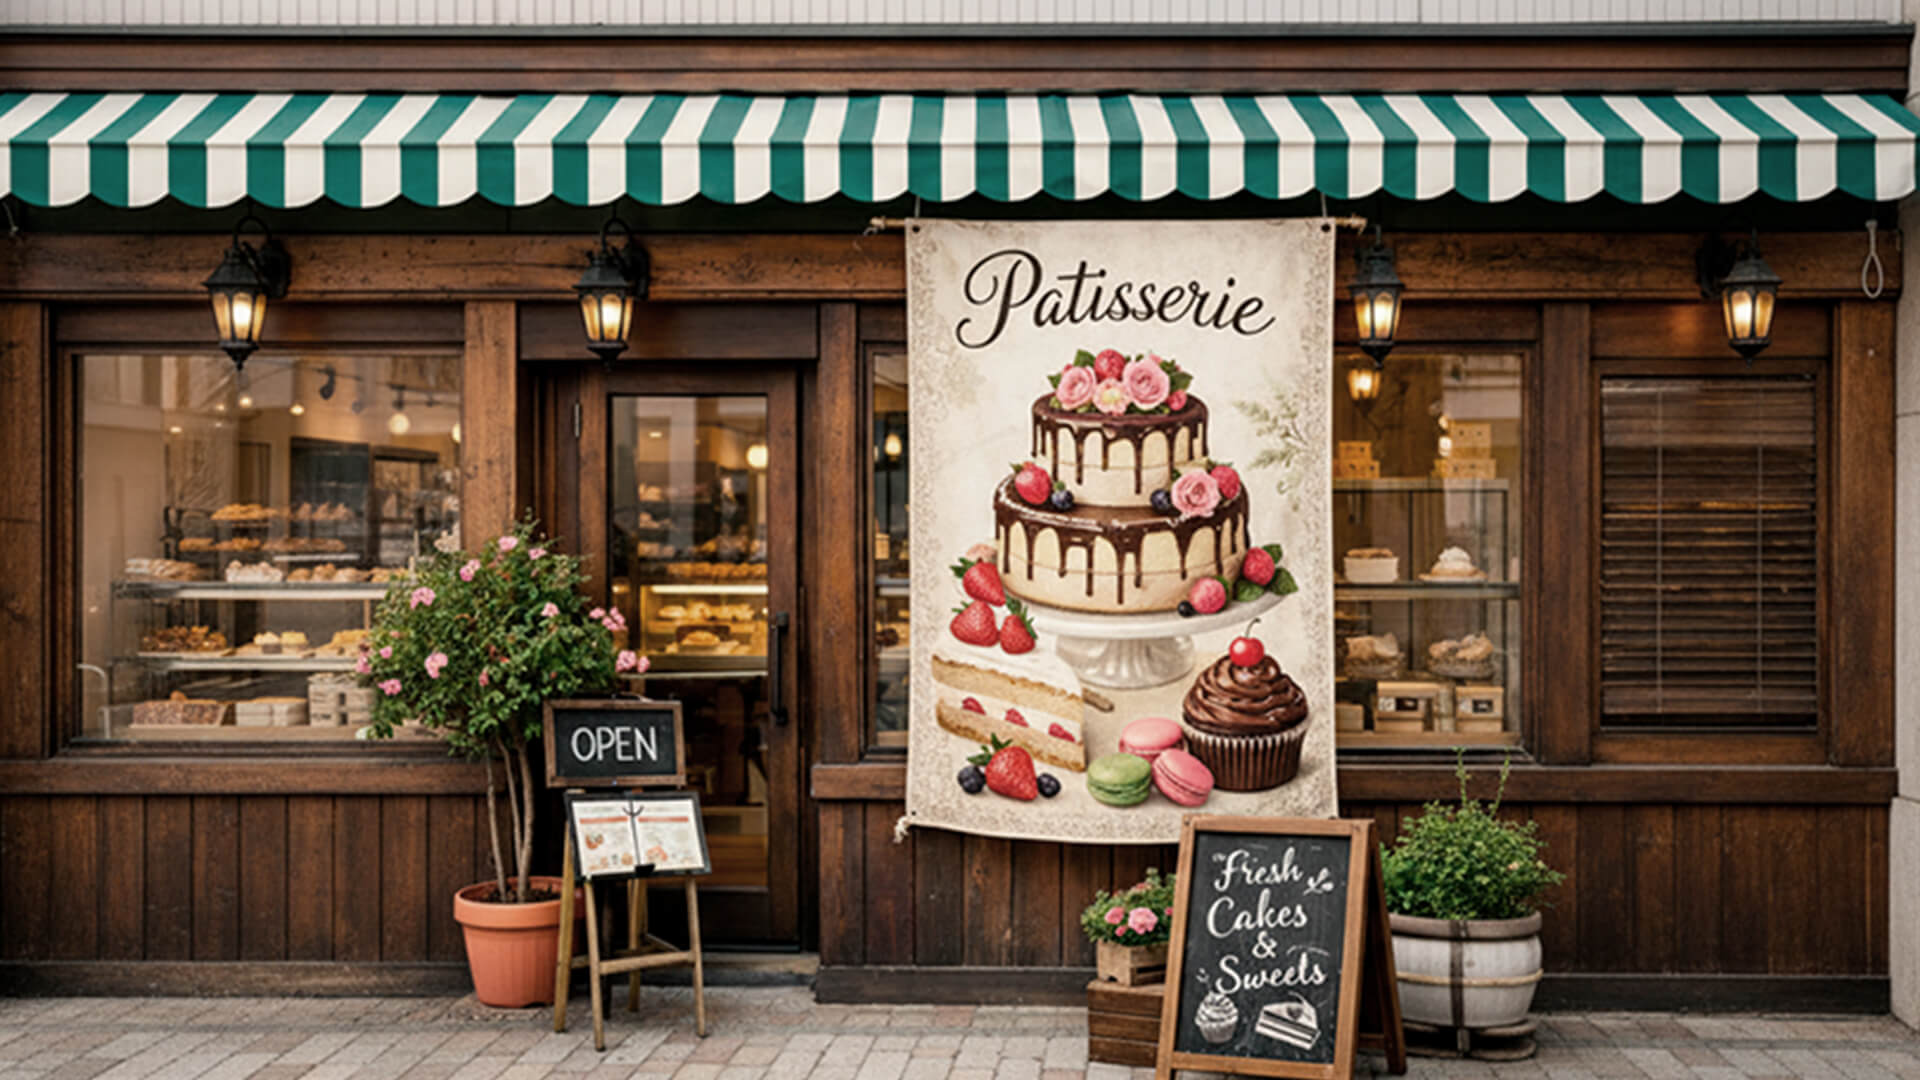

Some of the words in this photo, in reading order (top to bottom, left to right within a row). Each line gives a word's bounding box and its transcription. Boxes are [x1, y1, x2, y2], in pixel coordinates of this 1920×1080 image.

[956, 249, 1276, 349] Patisserie
[571, 726, 658, 762] OPEN
[1214, 846, 1304, 892] Fresh
[1207, 888, 1308, 938] Cakes
[1252, 930, 1278, 959] &
[1215, 952, 1328, 994] Sweets
